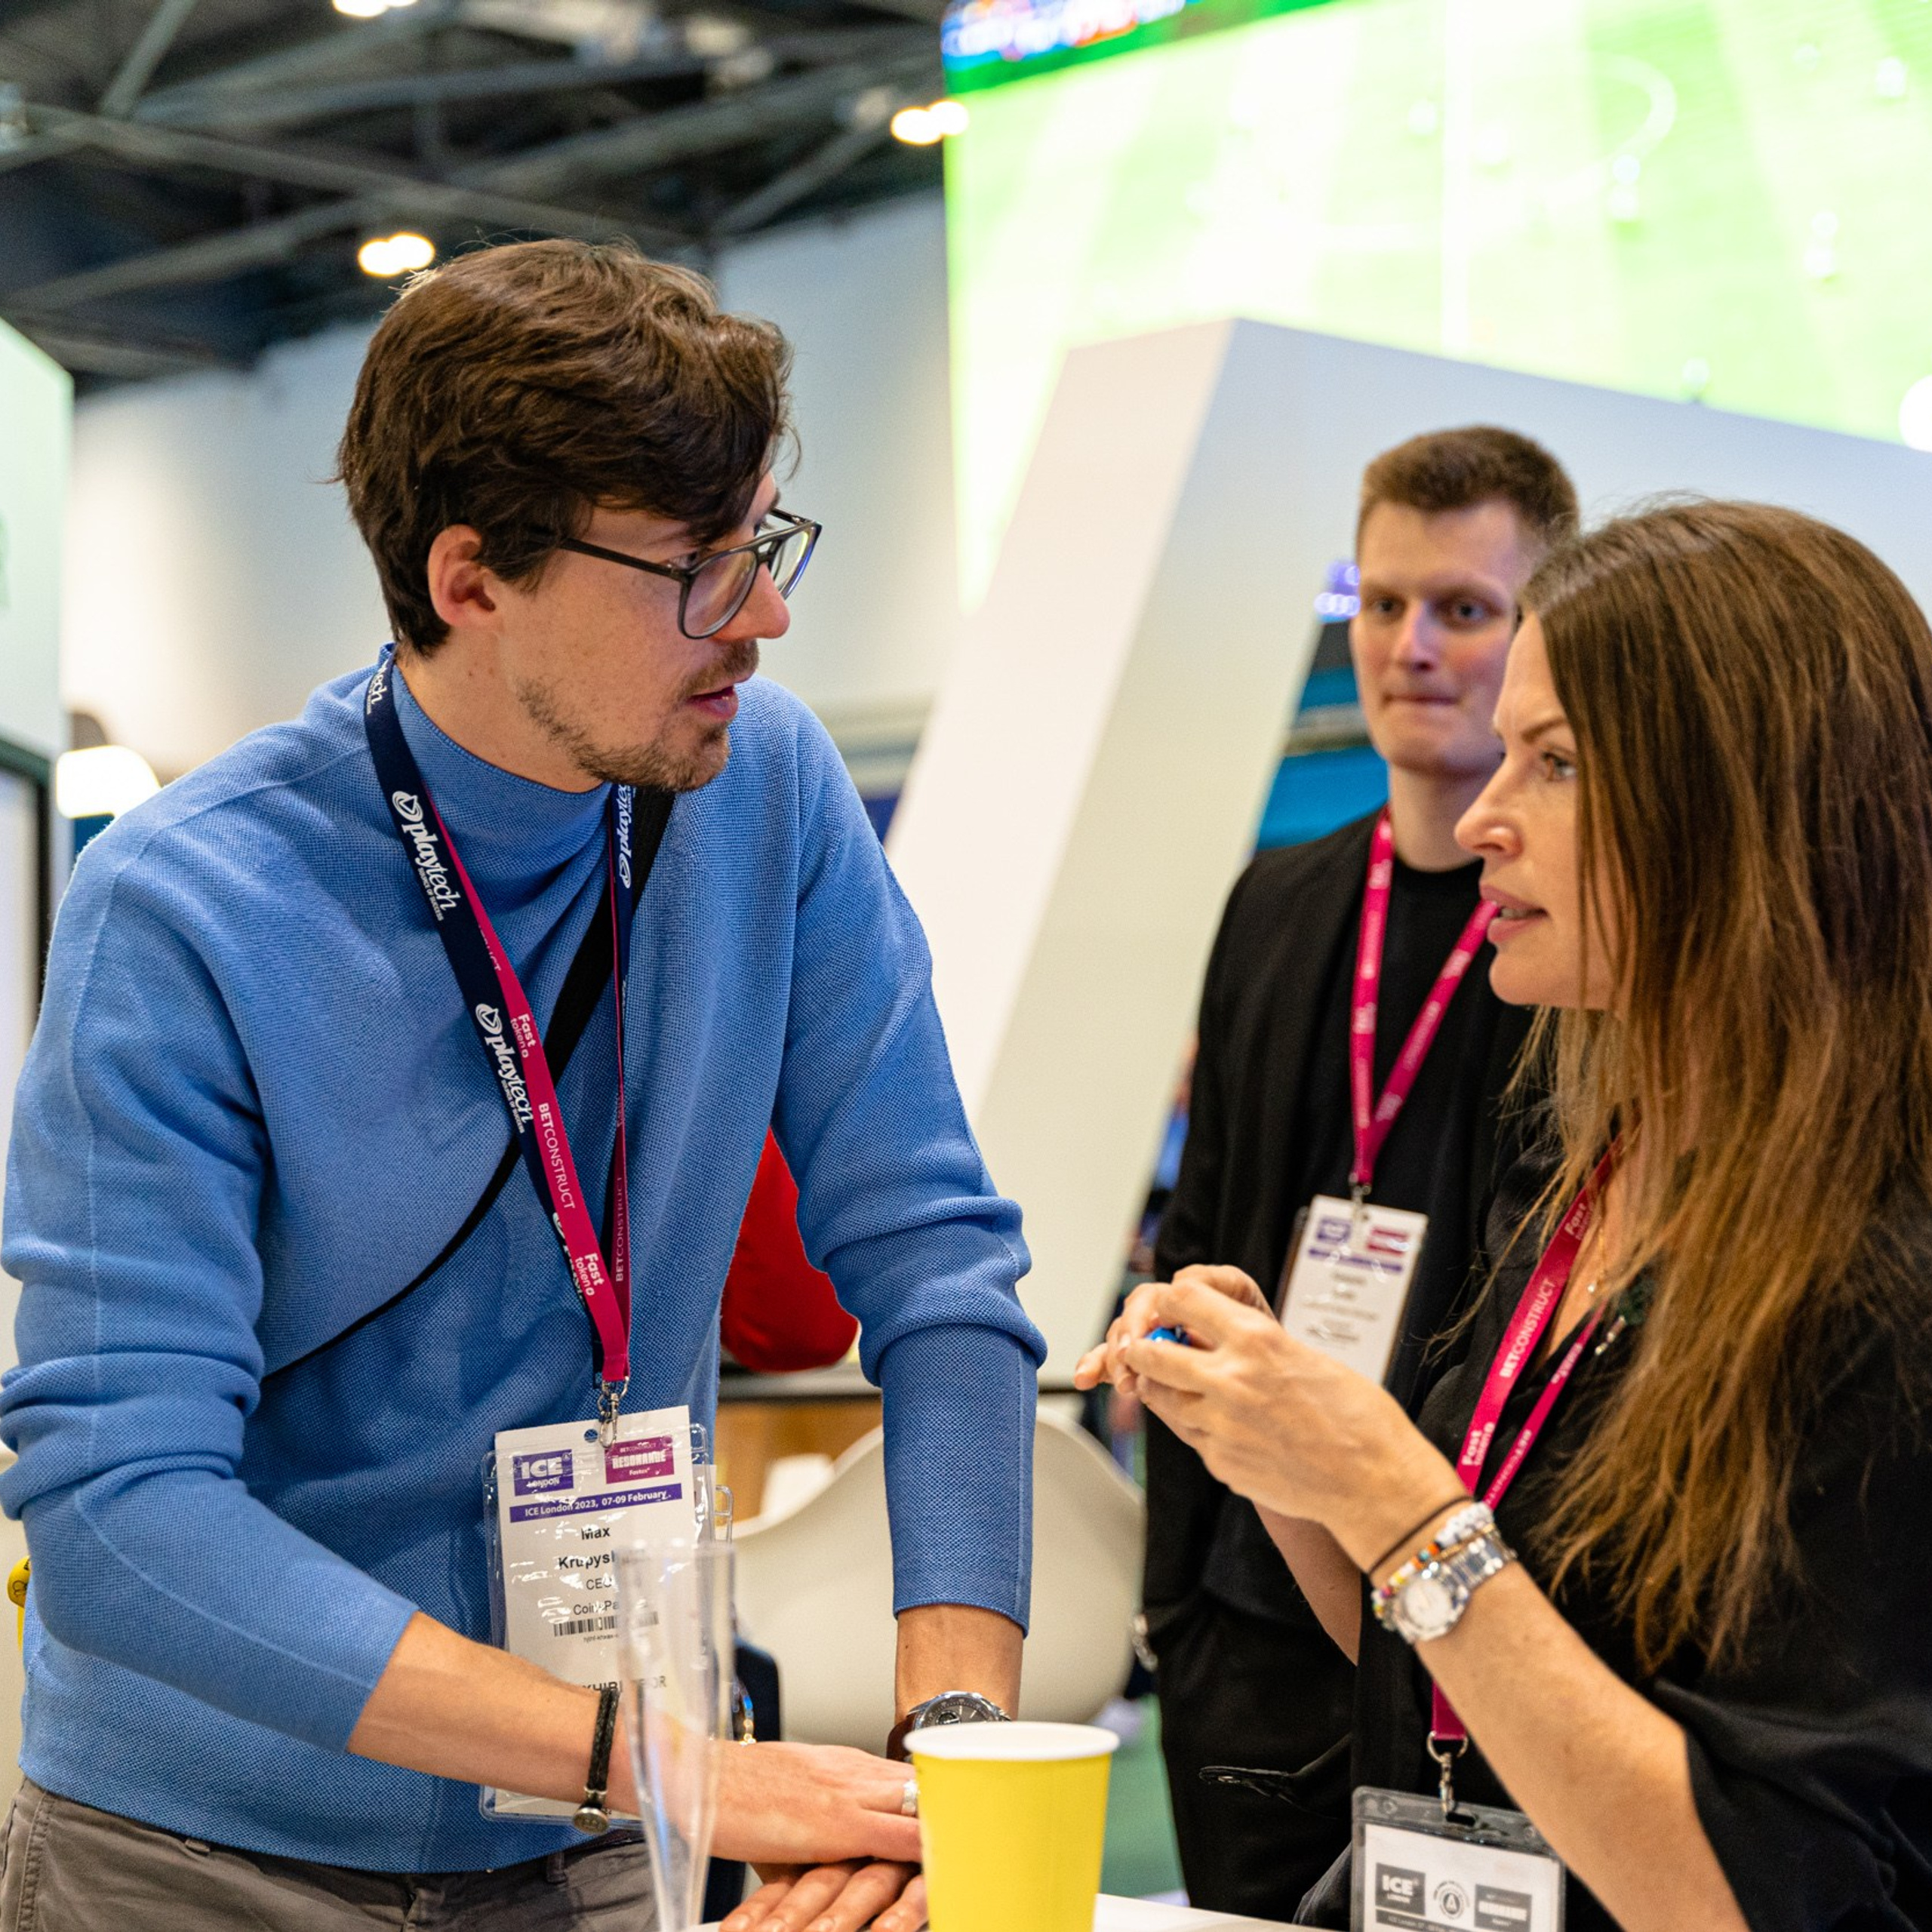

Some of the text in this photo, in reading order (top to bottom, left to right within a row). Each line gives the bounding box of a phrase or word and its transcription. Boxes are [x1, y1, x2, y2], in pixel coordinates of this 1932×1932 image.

[401, 822, 461, 911] playtech
[518, 1013, 537, 1048] Fast
[485, 1035, 534, 1124] playtech
[538, 1103, 576, 1209] BETCONSTRUCT
[584, 1253, 605, 1286] Fast
[1499, 1277, 1556, 1378] BETCONSTRUCT
[521, 1457, 564, 1479] ICE
[525, 1507, 539, 1517] ICE
[540, 1503, 573, 1515] London
[601, 1495, 627, 1506] 07-09
[581, 1527, 611, 1540] Max
[1382, 1874, 1414, 1897] ICE
